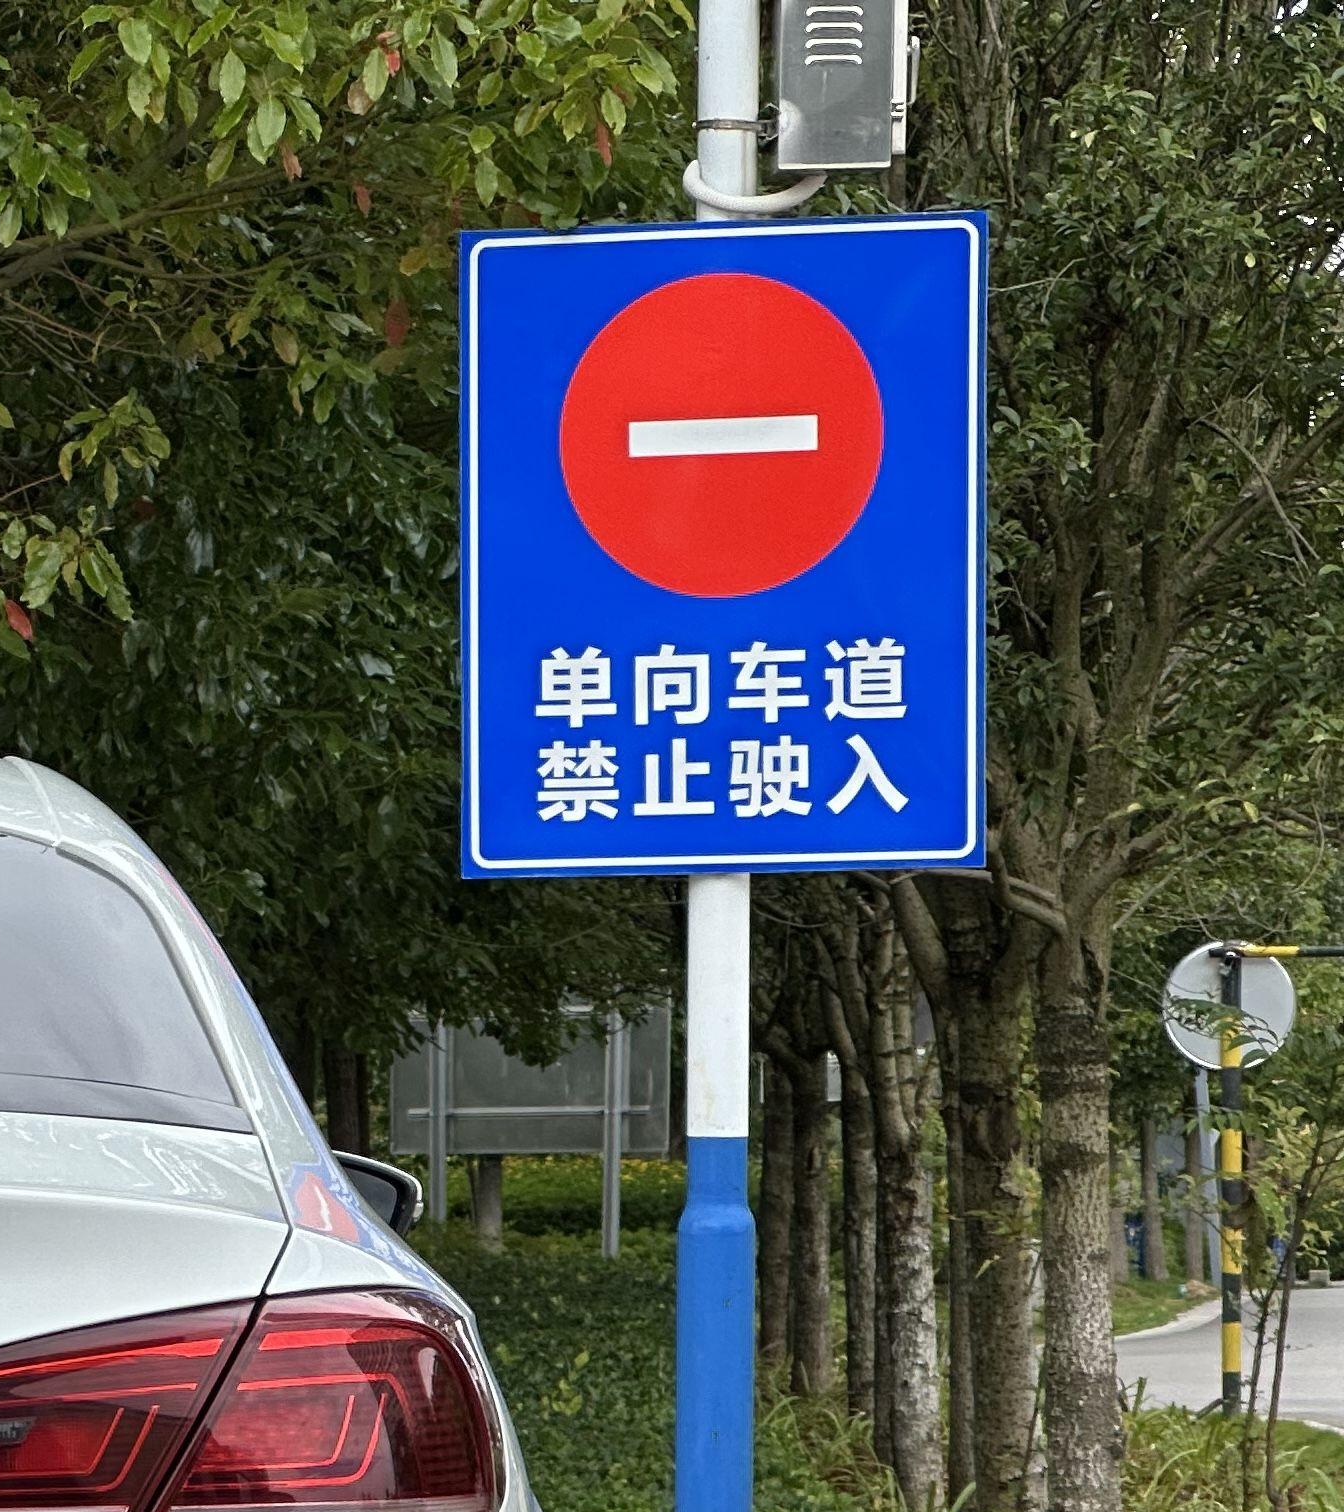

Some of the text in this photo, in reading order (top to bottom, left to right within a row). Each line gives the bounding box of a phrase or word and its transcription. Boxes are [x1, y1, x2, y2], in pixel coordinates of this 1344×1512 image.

[535, 638, 908, 727] 单向车道
[537, 734, 909, 821] 禁止驶入
